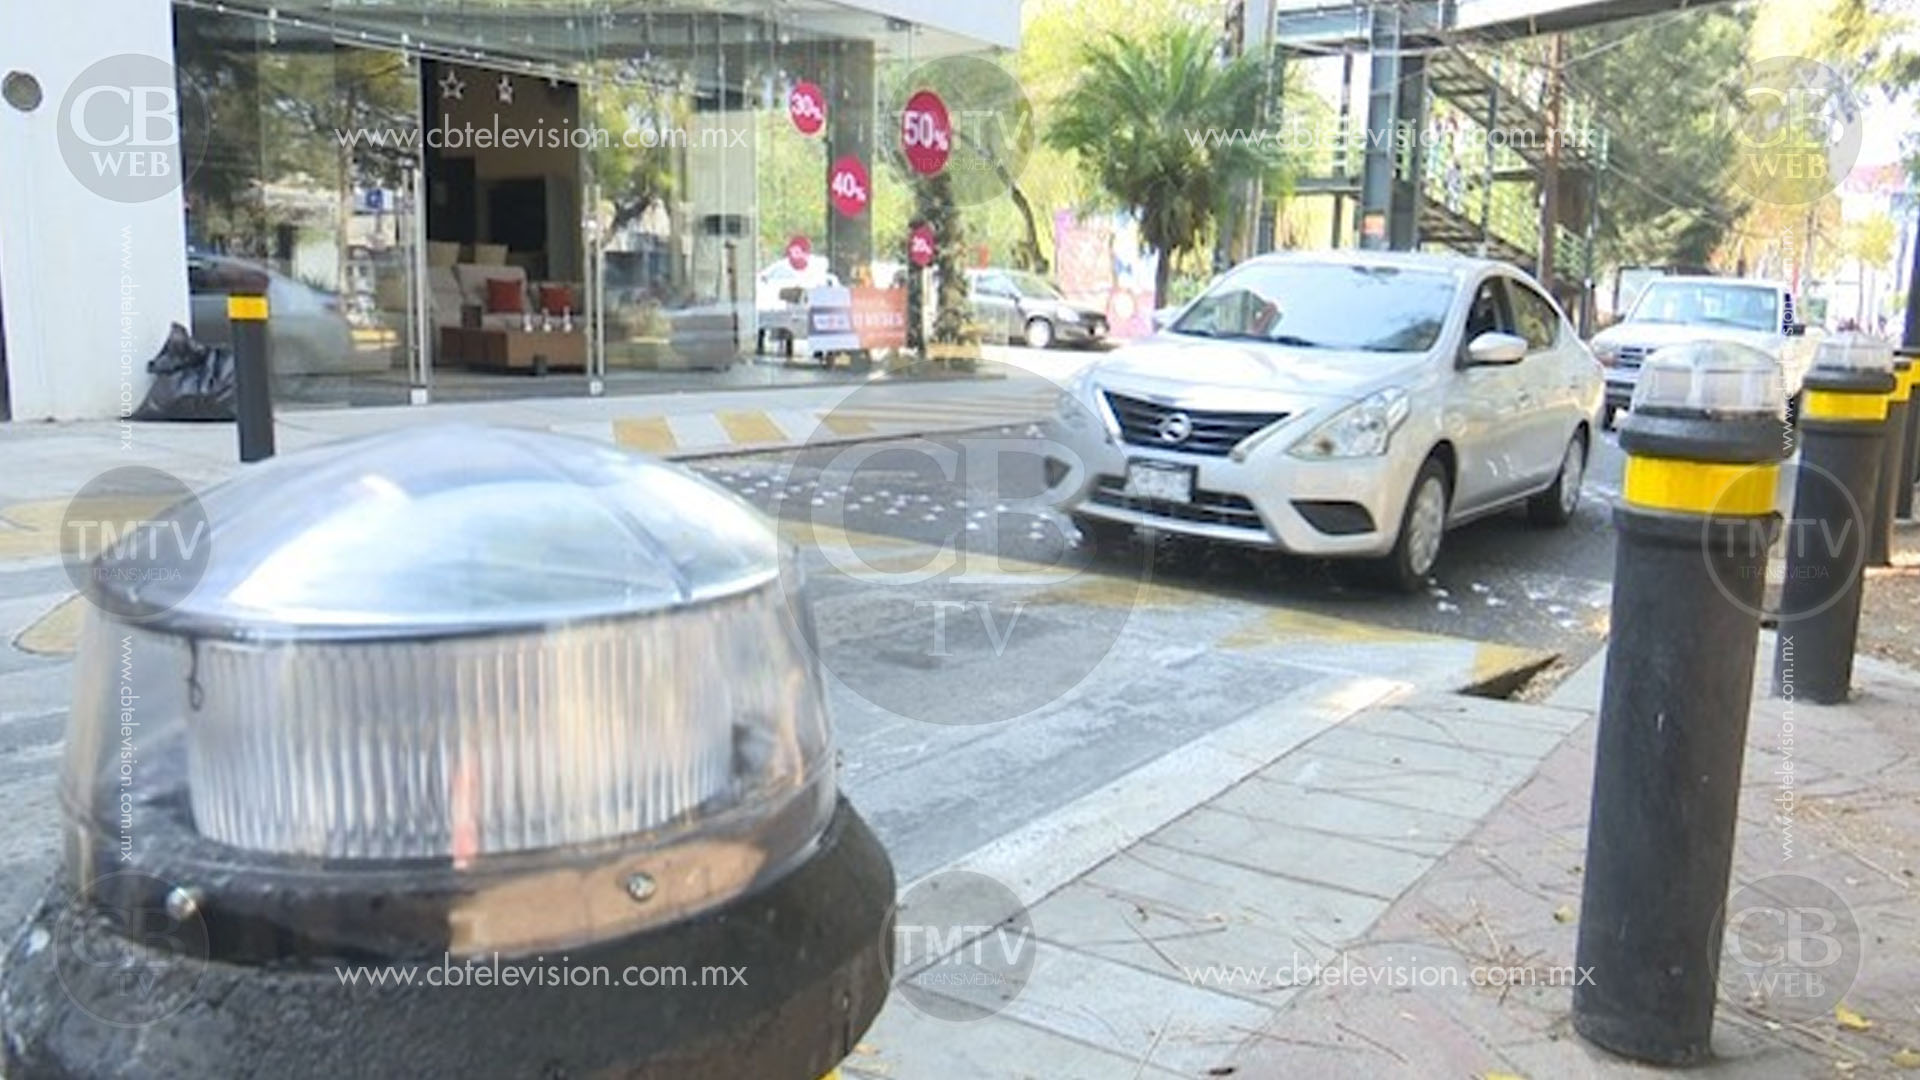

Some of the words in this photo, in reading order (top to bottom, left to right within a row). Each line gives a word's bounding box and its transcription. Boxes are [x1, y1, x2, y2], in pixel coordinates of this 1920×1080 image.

[791, 92, 823, 121] 30%
[904, 110, 949, 151] 50%
[831, 170, 866, 201] 40%
